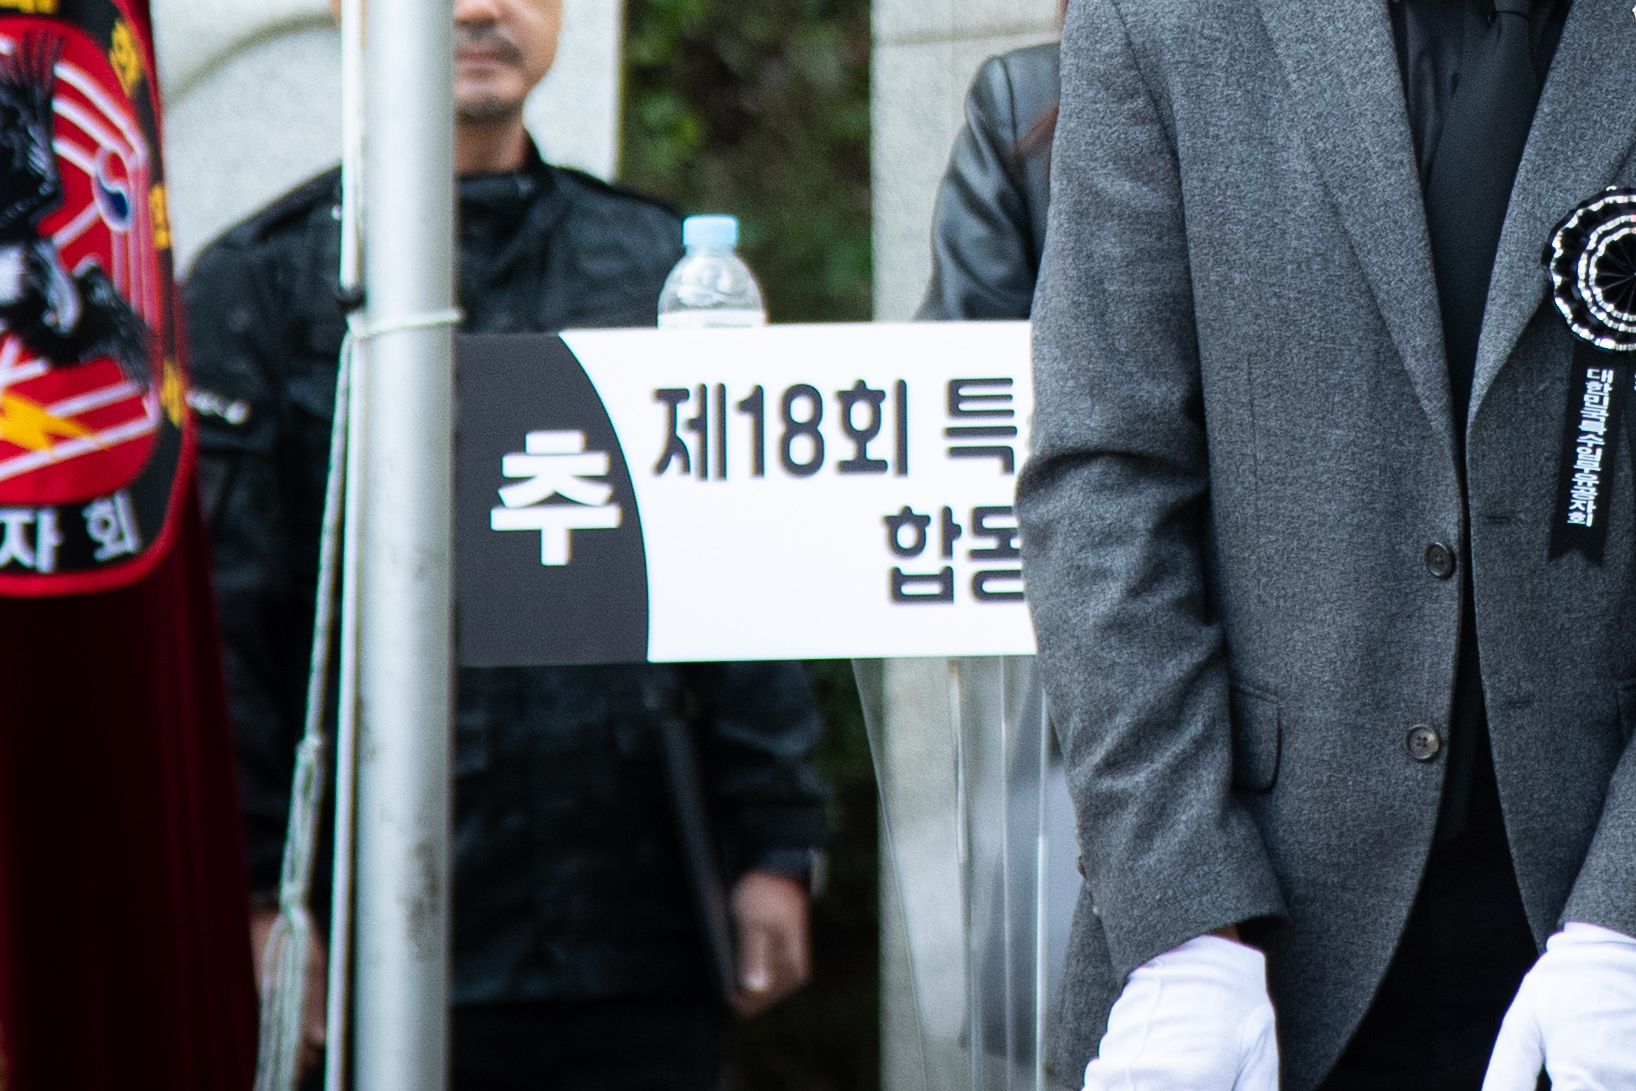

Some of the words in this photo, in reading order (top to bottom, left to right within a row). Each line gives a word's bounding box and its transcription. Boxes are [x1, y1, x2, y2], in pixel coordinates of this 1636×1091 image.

[653, 378, 908, 480] 제18회
[942, 377, 1030, 474] 특
[490, 429, 622, 566] 추
